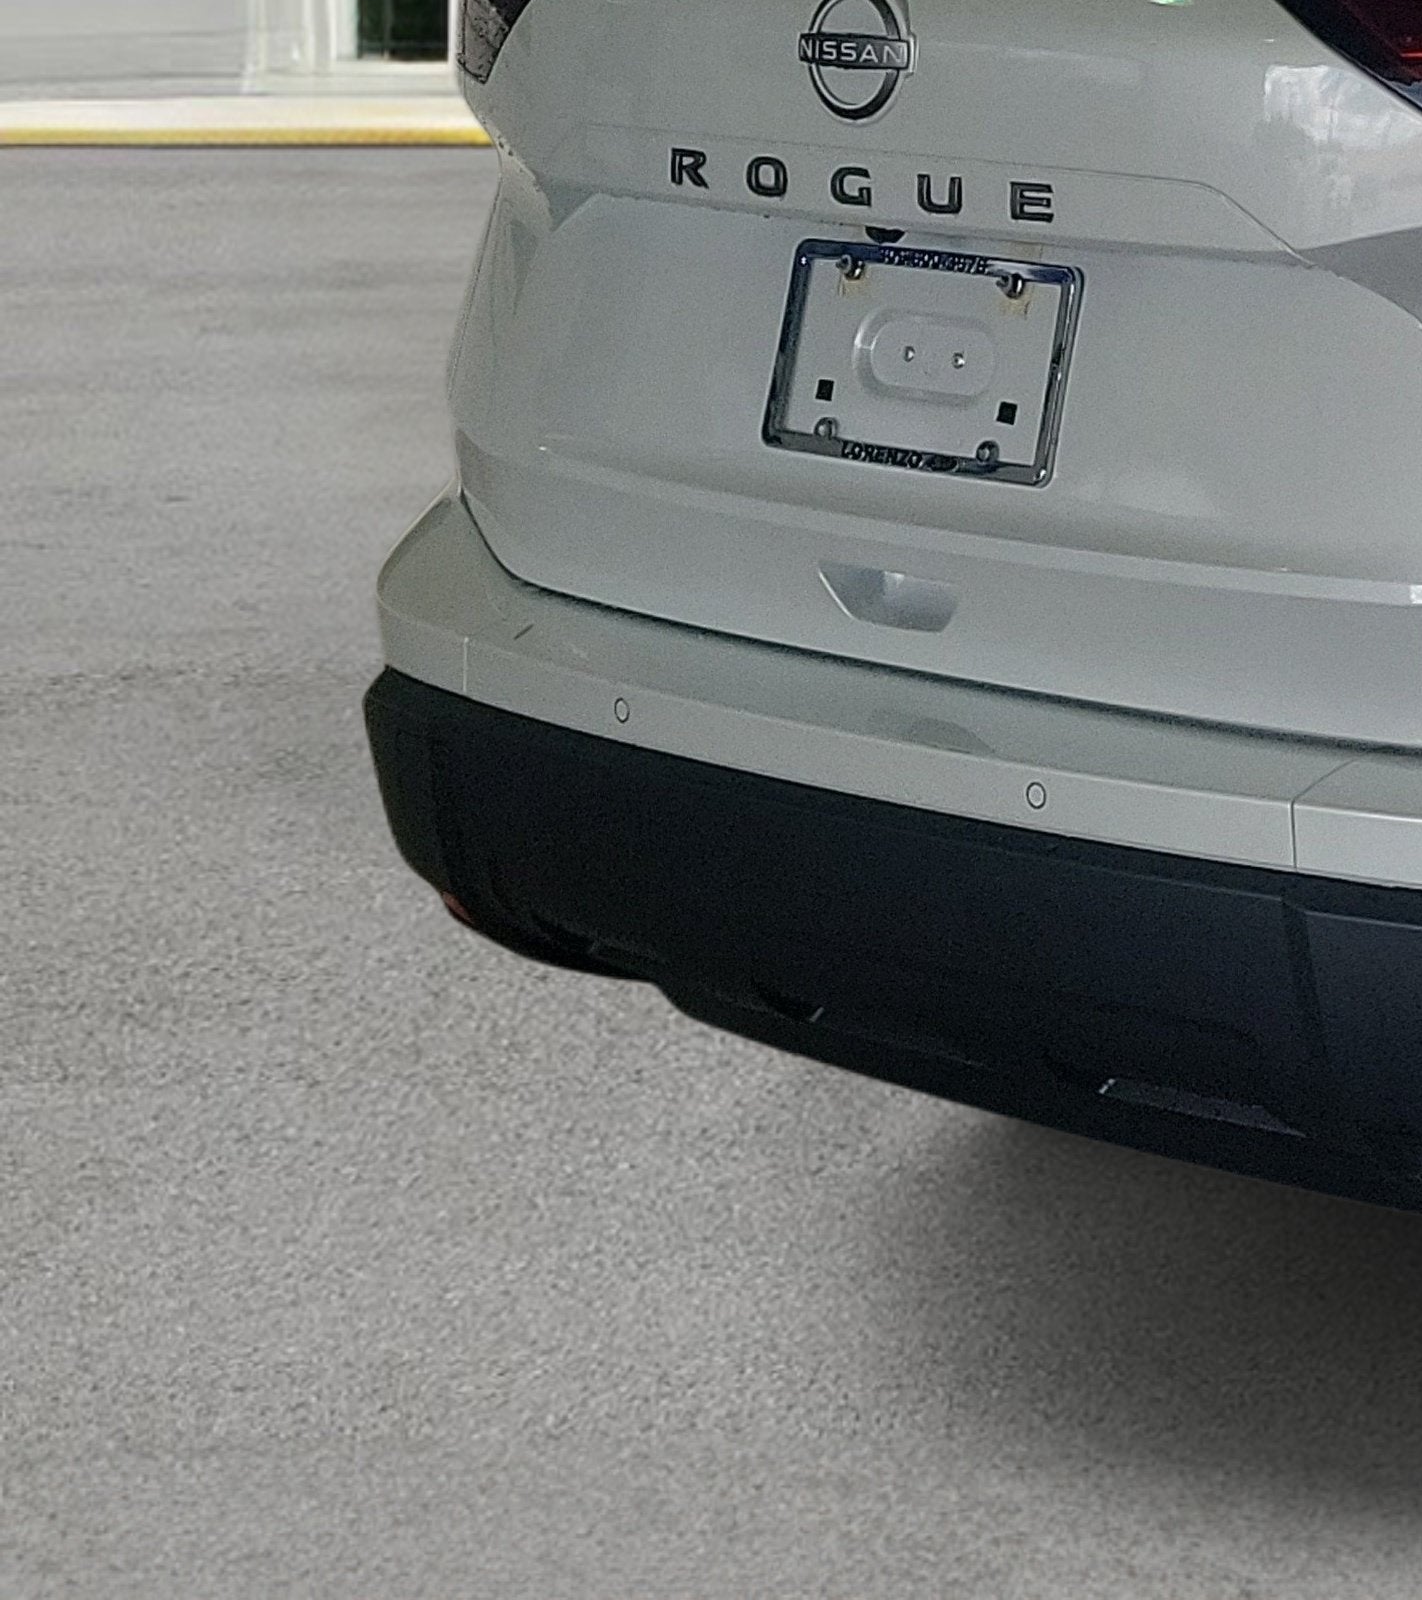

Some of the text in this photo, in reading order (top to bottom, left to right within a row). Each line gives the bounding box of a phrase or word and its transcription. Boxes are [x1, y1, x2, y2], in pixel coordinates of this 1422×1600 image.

[799, 38, 908, 64] NISSAN
[670, 147, 1055, 224] ROGUE
[841, 440, 923, 469] LORENZO
